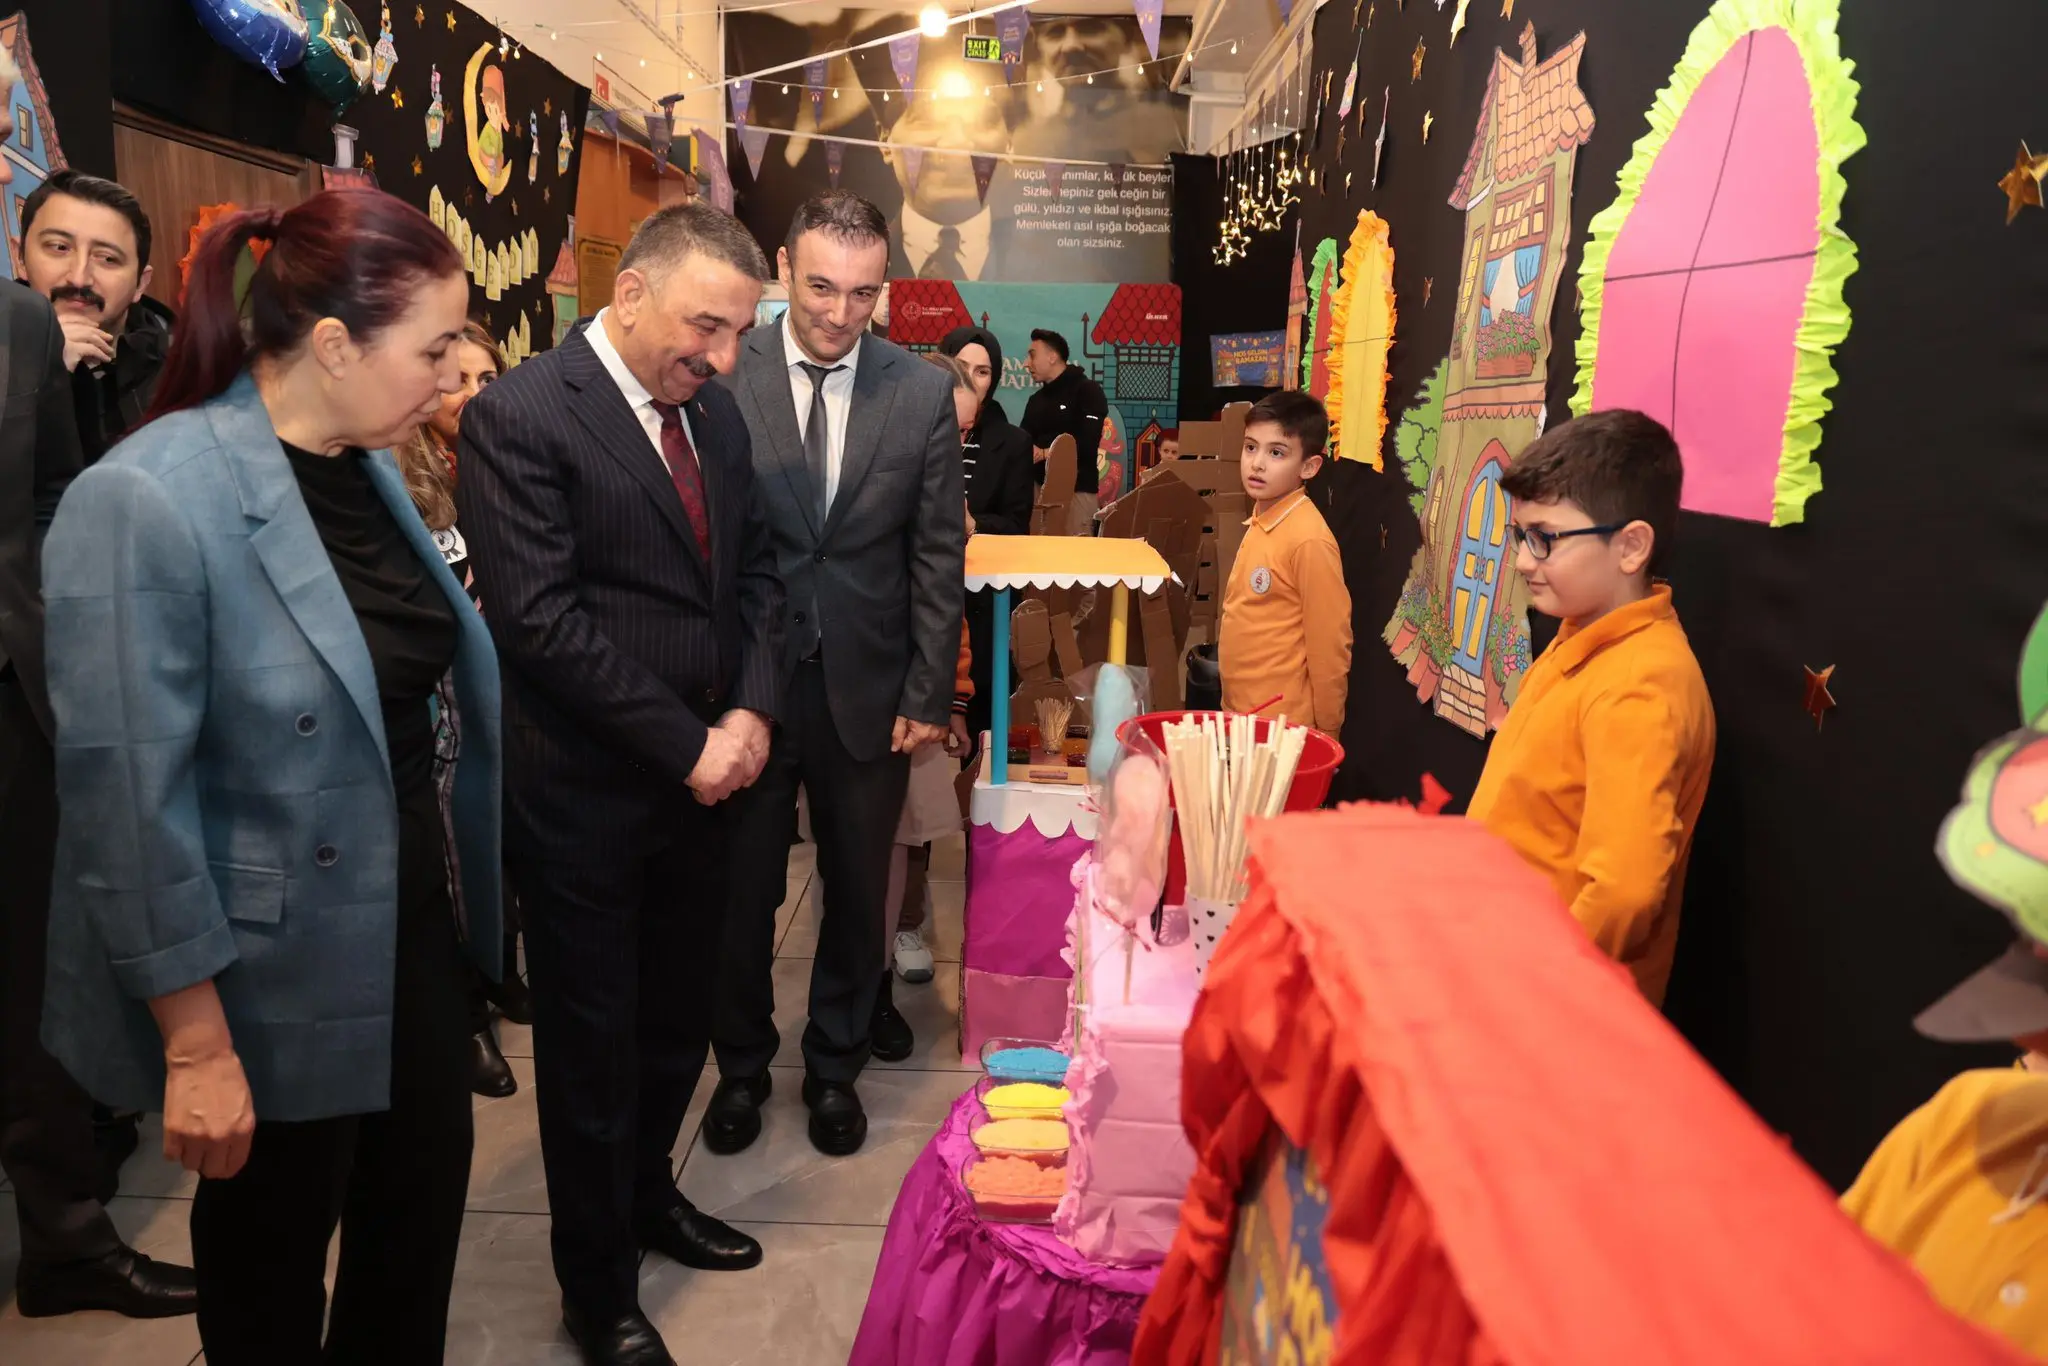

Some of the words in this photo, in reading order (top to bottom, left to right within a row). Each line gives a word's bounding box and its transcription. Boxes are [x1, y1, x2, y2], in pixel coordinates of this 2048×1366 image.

[967, 40, 987, 49] EXIT
[1152, 188, 1166, 199] bir
[1043, 203, 1075, 215] yıldızı
[1078, 206, 1091, 215] ve
[1094, 204, 1119, 215] ikbal
[1016, 219, 1071, 231] Memleketi
[1074, 220, 1093, 231] asıl
[1096, 221, 1122, 234] ışığa
[1125, 221, 1171, 235] boğacak
[1057, 236, 1080, 247] olan
[1083, 237, 1125, 248] sizsiniz.
